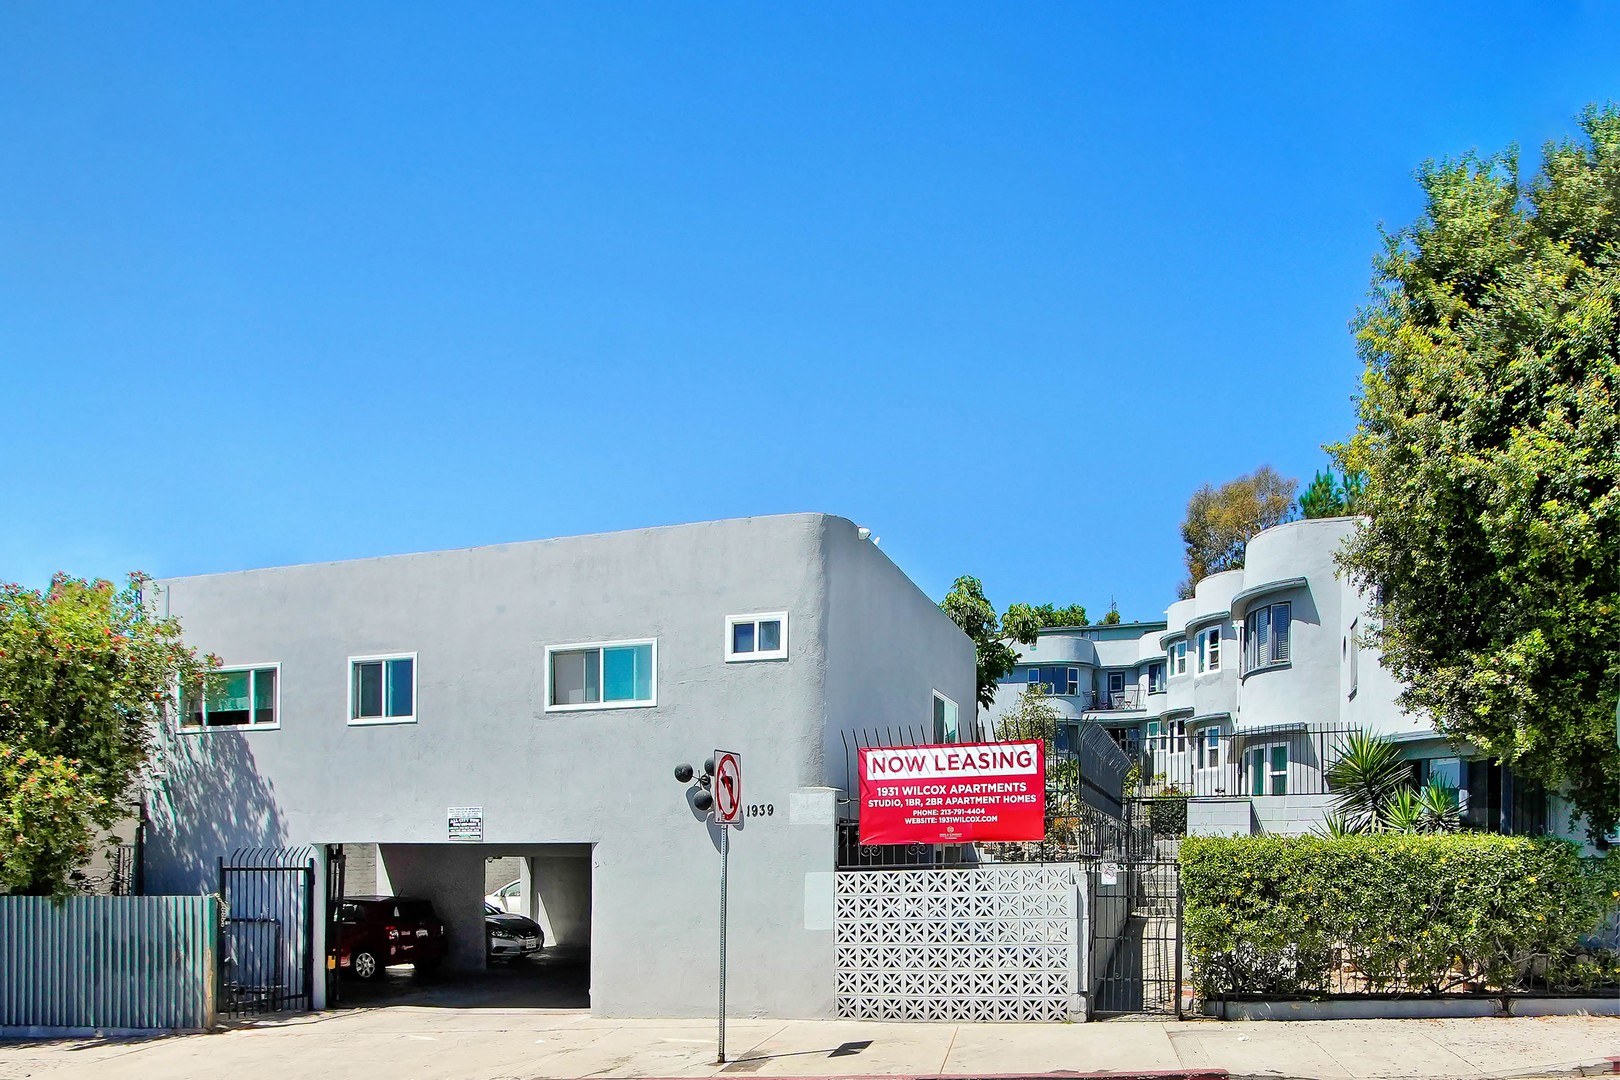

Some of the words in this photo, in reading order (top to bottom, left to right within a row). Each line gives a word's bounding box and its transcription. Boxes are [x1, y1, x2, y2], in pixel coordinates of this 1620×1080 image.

[872, 755, 927, 774] NOW
[934, 750, 1032, 772] LEASING
[876, 785, 899, 797] 1931
[902, 784, 947, 796] WILCOX
[949, 781, 1027, 795] APARTMENTS
[868, 799, 903, 808] STUDIO,
[905, 798, 924, 807] 1BR,
[925, 797, 943, 806] 2BR
[945, 795, 1001, 805] APARTMENT
[1003, 794, 1037, 803] HOMES
[746, 804, 774, 818] 1939
[940, 807, 986, 815] 213-791-4404
[938, 815, 998, 823] 1931WILCOX.COM
